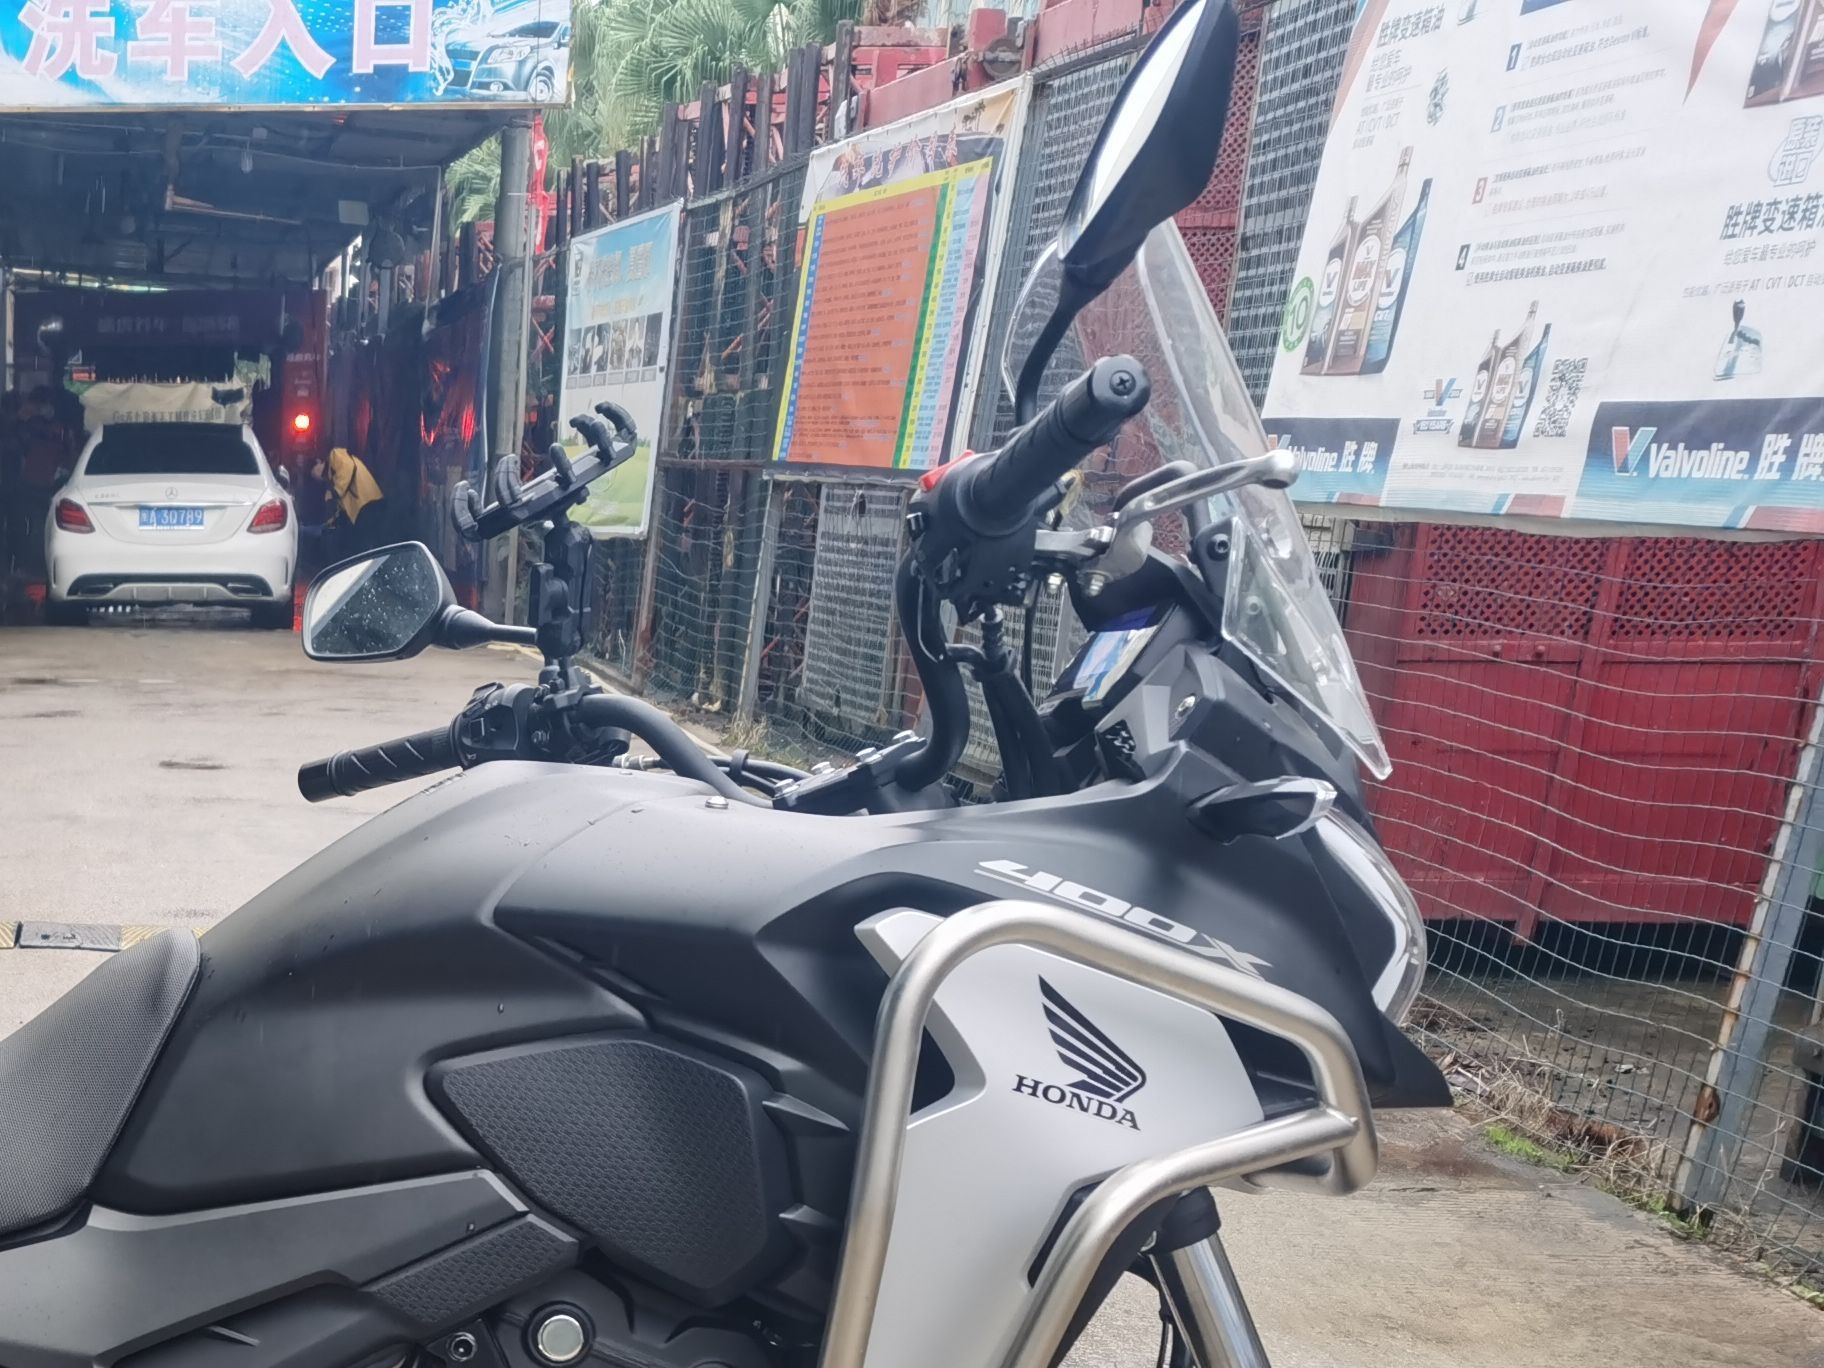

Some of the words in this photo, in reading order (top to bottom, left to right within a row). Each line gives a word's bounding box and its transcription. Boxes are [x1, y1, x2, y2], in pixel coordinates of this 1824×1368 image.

[17, 0, 433, 80] 洗车入口
[1720, 192, 1824, 241] 胜牌变速箱
[1765, 275, 1783, 290] CVT
[1787, 274, 1806, 289] DCT
[975, 860, 1273, 980] 400X
[1012, 1074, 1140, 1131] HONDA
